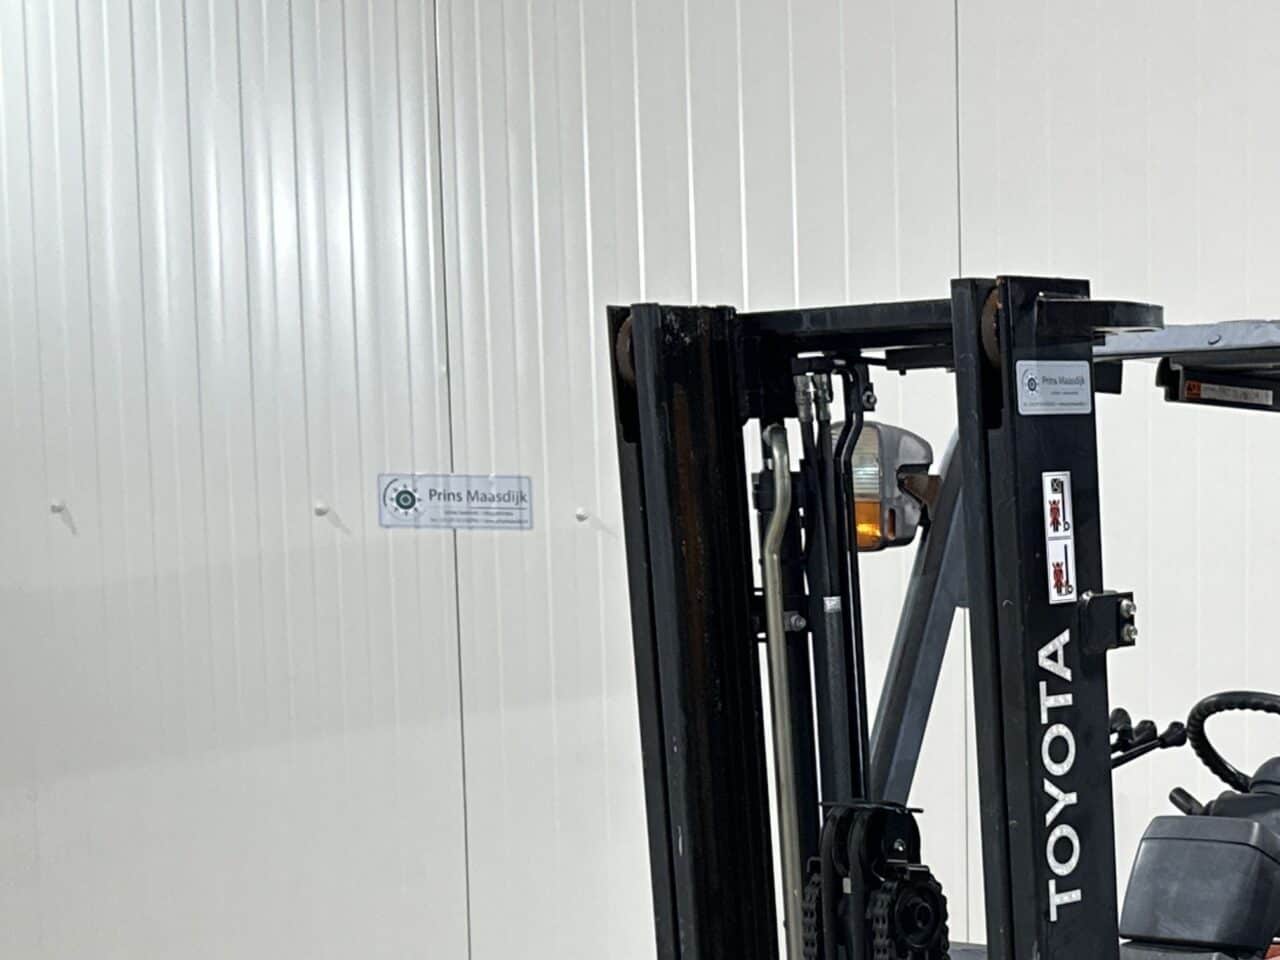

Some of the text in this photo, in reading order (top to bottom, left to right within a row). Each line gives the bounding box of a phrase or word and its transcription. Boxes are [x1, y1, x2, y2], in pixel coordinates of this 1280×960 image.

[428, 488, 528, 506] Prins Maasdijk
[1038, 628, 1082, 922] TOYOTA
